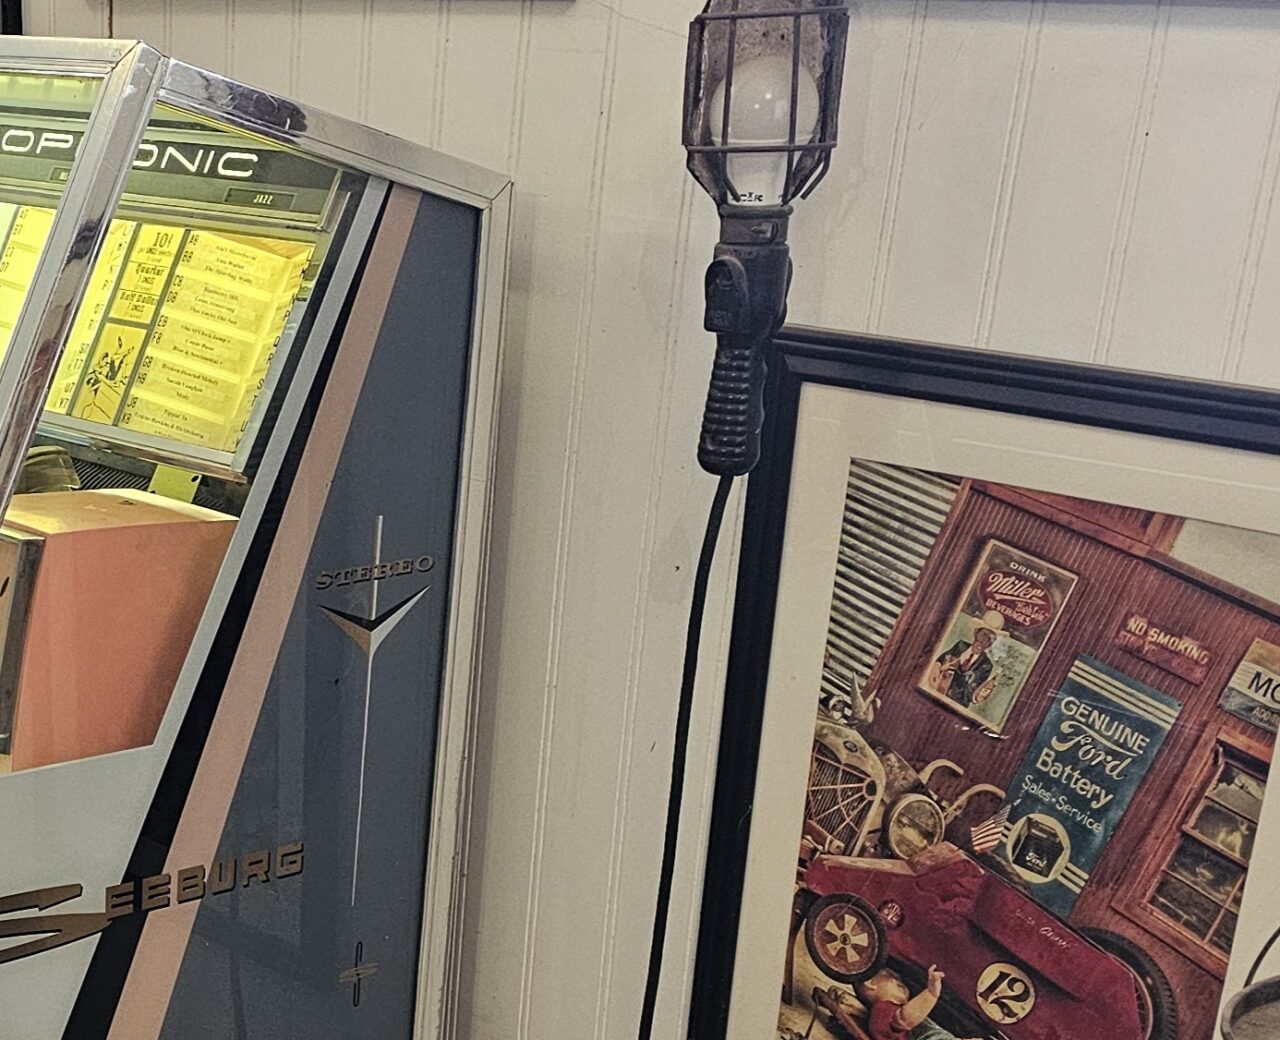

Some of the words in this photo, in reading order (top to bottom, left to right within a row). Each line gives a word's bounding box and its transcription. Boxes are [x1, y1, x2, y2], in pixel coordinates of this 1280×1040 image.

[253, 194, 273, 205] JAZZ
[315, 555, 435, 590] STEREO
[986, 573, 1046, 600] Miller
[1010, 562, 1047, 583] DRINK
[986, 599, 1031, 626] BEVERAGES
[1127, 618, 1147, 635] NO
[1149, 628, 1210, 665] SMOKING
[1061, 696, 1150, 754] GENUINE
[1051, 720, 1138, 780] Ford
[1035, 747, 1114, 808] Battery
[979, 970, 1031, 1019] 12
